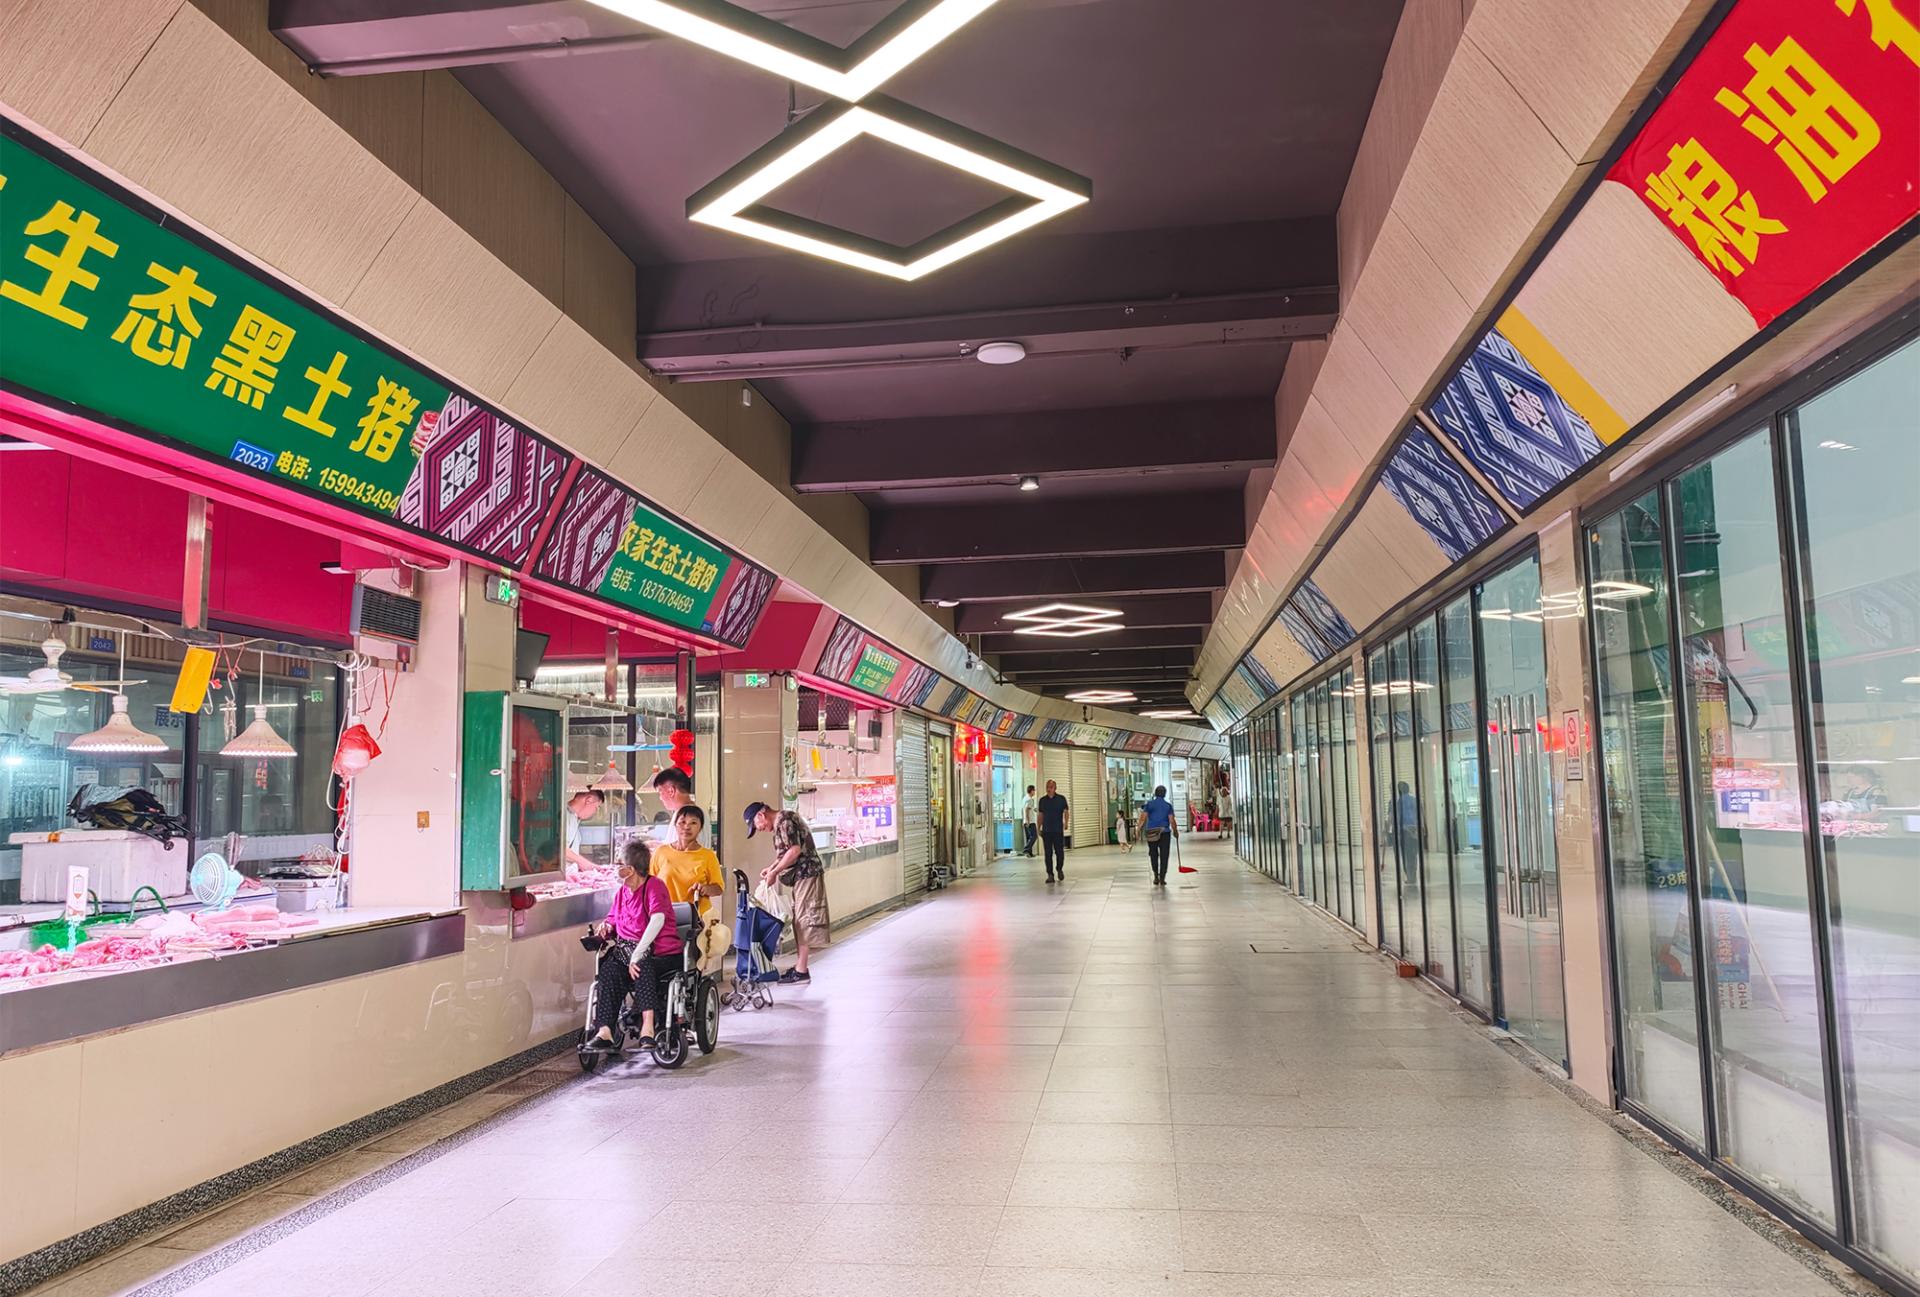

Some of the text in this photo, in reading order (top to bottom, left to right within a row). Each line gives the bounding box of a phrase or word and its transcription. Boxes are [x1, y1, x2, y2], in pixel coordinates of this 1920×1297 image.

[0, 174, 421, 463] 生态黑土猪
[234, 447, 269, 471] 2023
[638, 578, 695, 614] 18376784693
